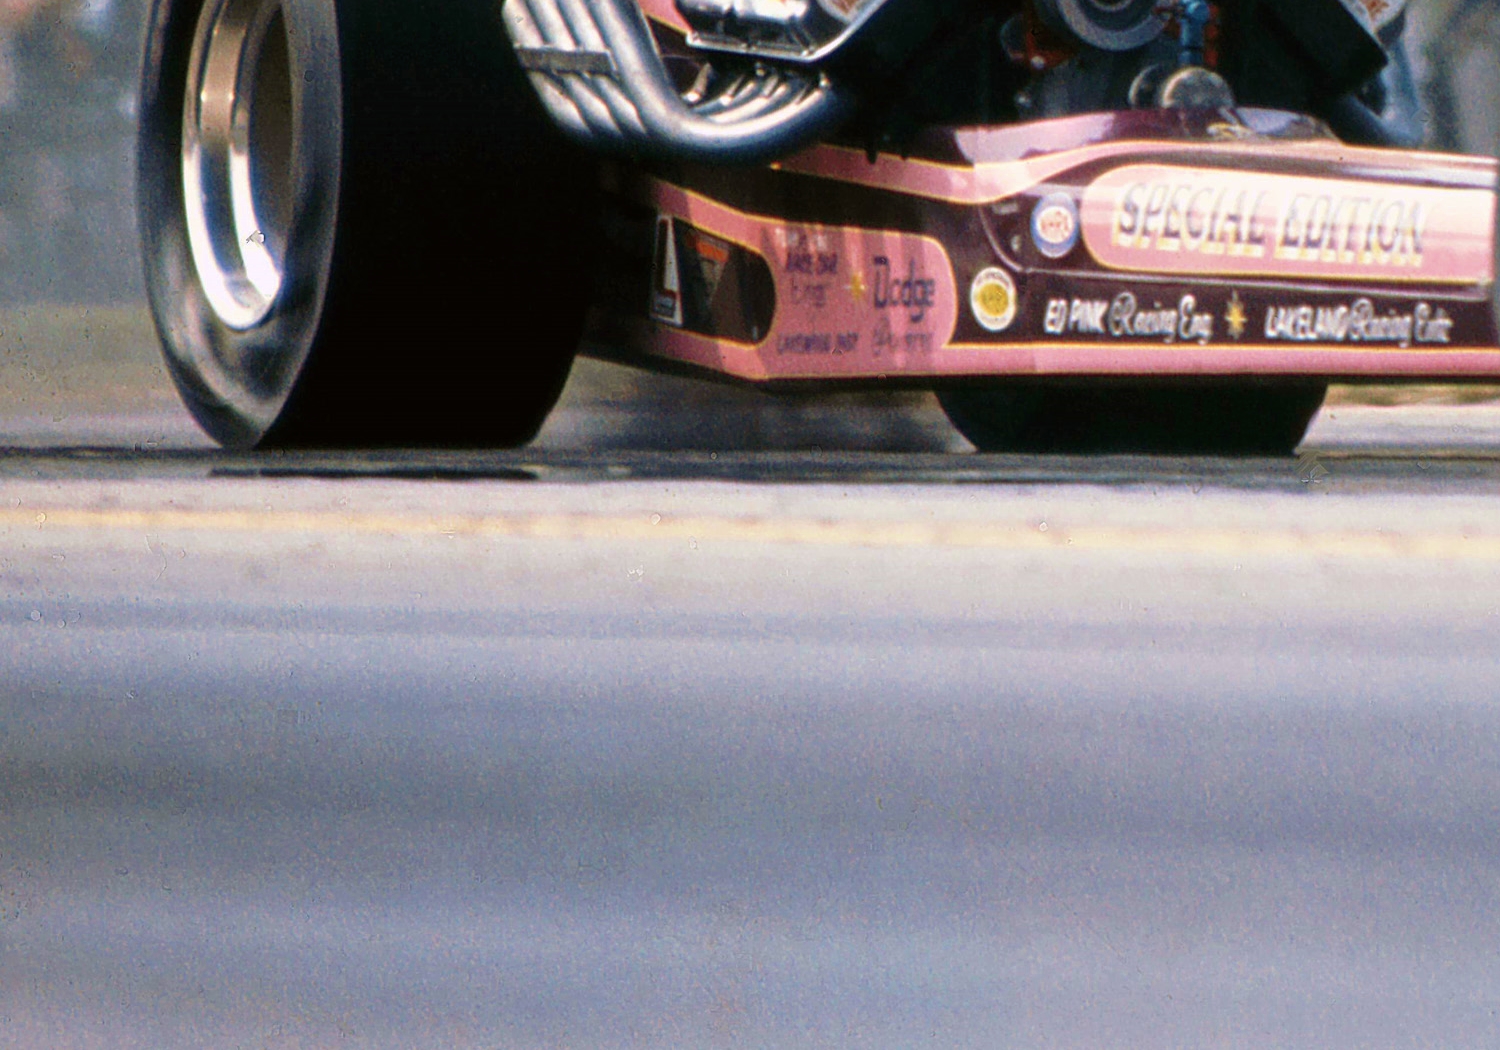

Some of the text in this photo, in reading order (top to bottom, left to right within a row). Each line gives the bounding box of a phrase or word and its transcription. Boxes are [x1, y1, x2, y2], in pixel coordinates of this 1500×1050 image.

[1114, 181, 1427, 266] SPECIAL EDITION
[871, 253, 935, 324] Dodge
[1044, 299, 1068, 335] ED
[1068, 298, 1109, 335] PINK
[1108, 291, 1178, 344] Racing
[1349, 297, 1413, 349] Racing
